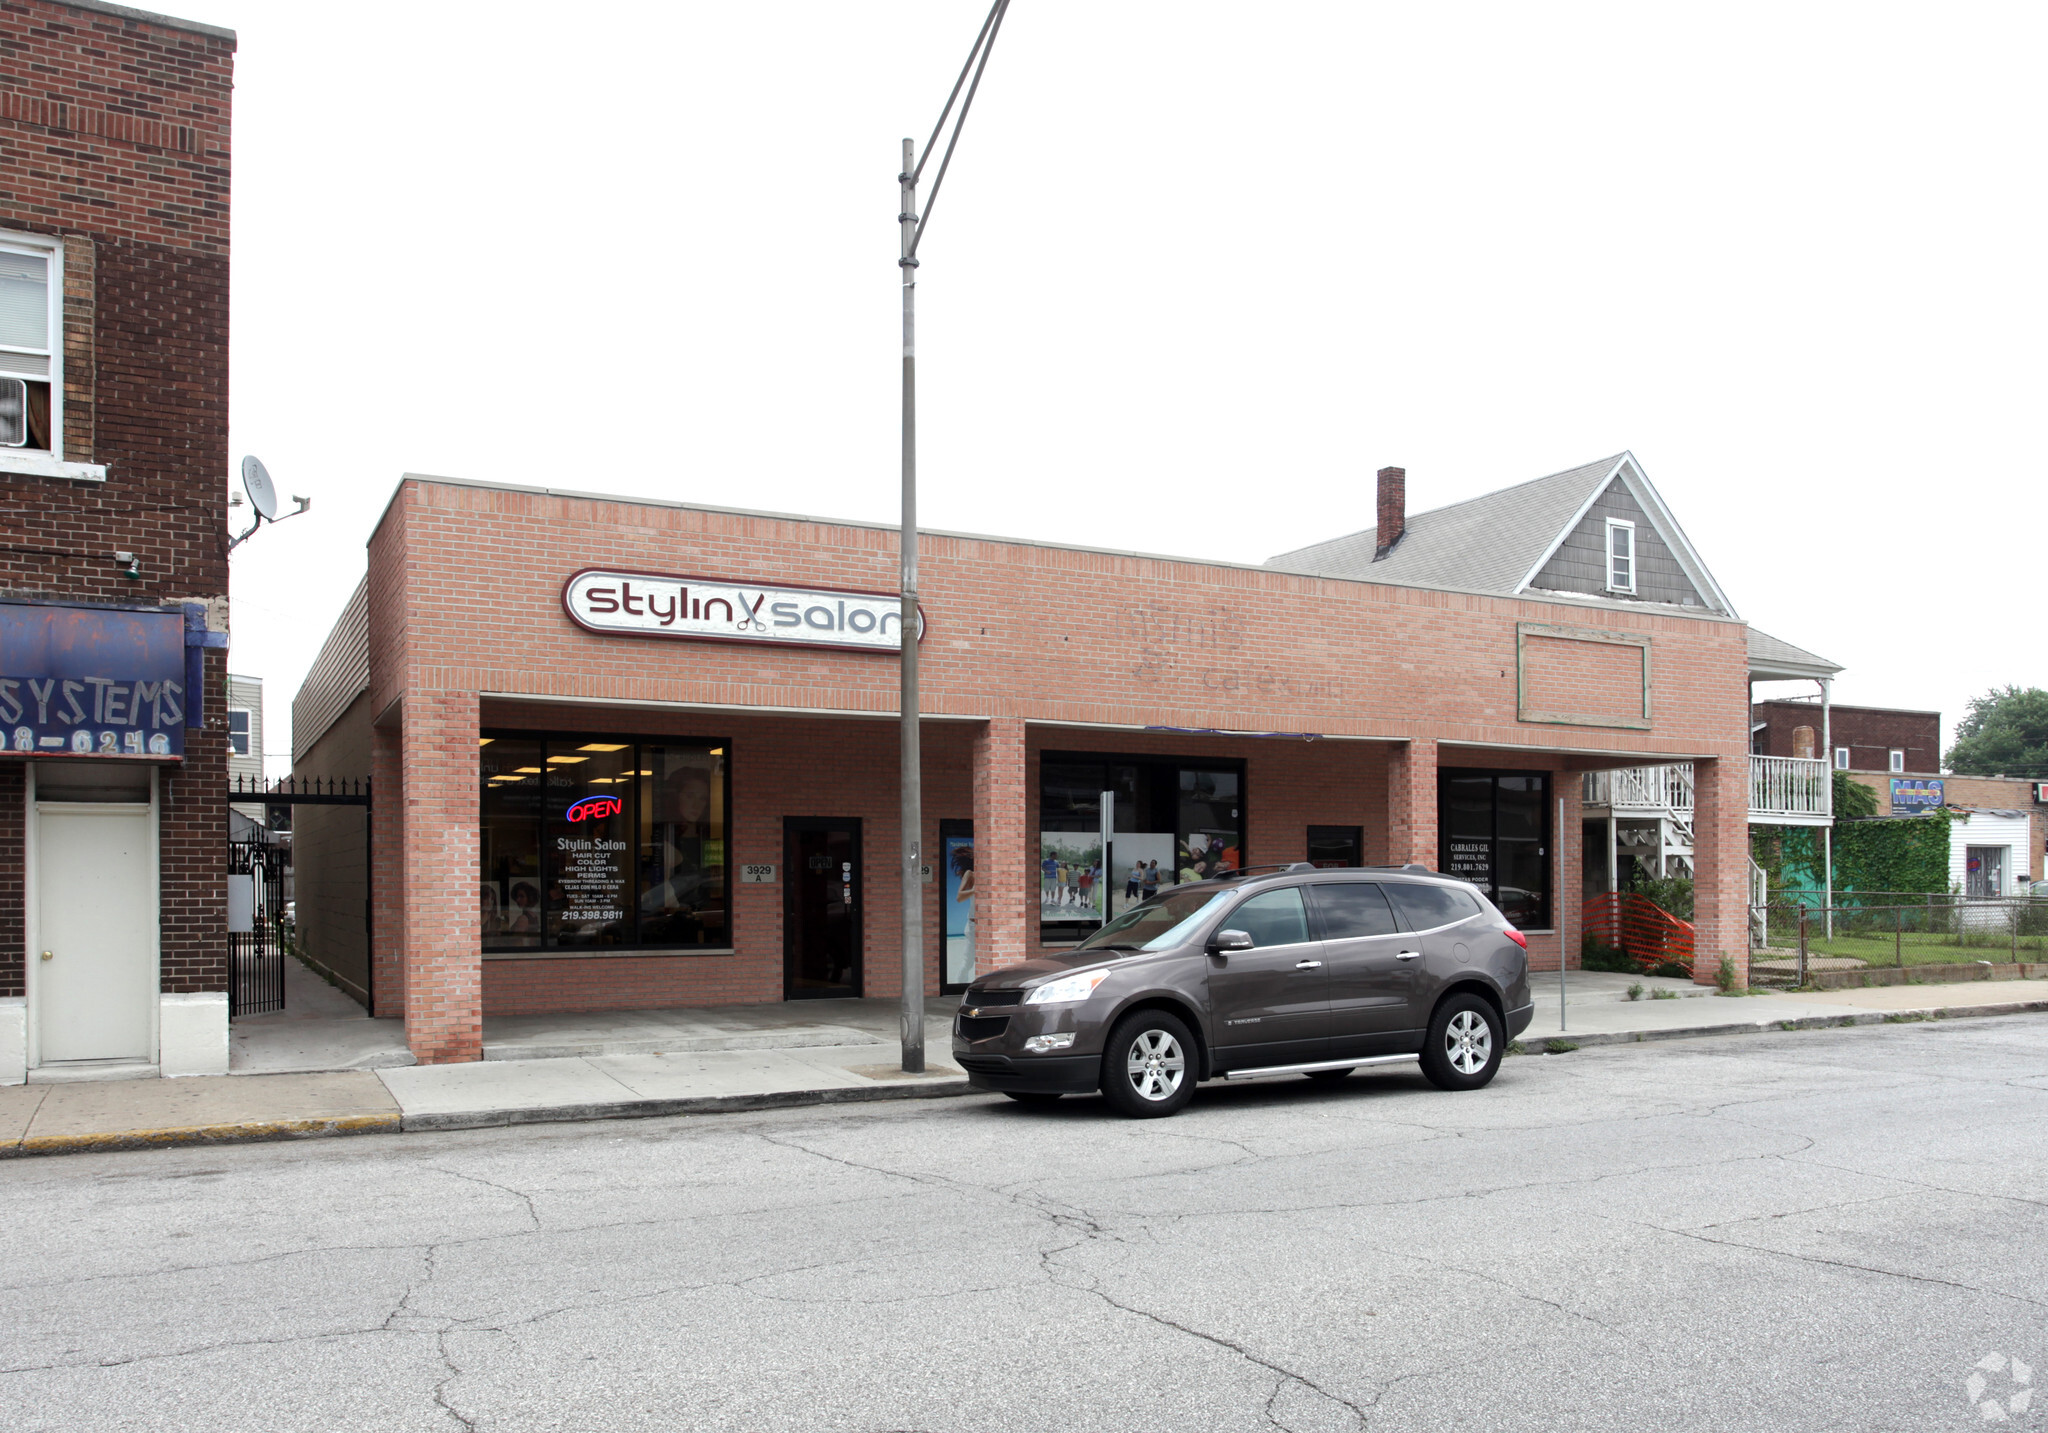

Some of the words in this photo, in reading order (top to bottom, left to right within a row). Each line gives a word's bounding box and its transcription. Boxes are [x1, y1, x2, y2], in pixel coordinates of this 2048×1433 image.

[586, 582, 733, 626] stylin
[771, 601, 902, 635] salon
[0, 676, 183, 729] SYSTEMS
[1892, 780, 1943, 806] MAS
[569, 798, 622, 822] OPEN
[557, 837, 592, 852] Stylin
[594, 838, 626, 851] Salon
[1450, 843, 1479, 852] CABRALES
[1479, 844, 1489, 852] GIL
[747, 865, 771, 875] 3929
[755, 874, 762, 882] A
[561, 910, 624, 920] 219.398.9811
